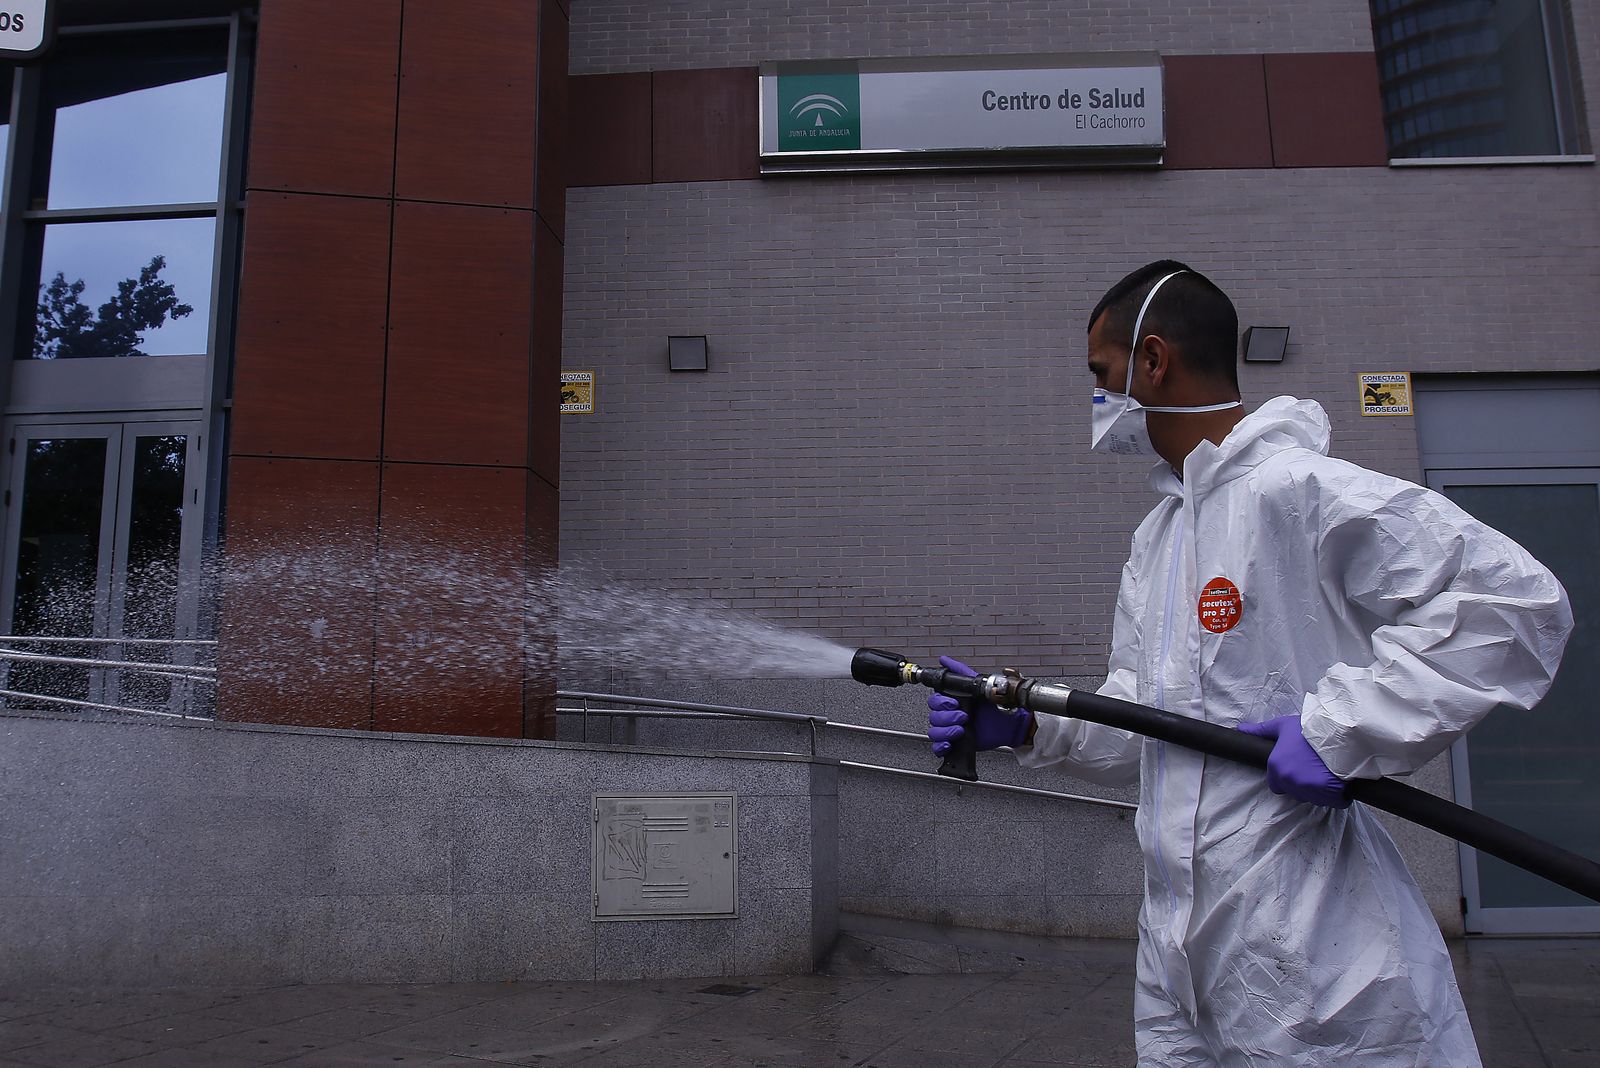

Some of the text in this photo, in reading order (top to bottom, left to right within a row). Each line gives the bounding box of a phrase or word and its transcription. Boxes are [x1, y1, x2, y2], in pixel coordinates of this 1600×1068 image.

[981, 87, 1145, 111] Centro de Salud
[1075, 113, 1146, 129] El Cachorro
[1203, 610, 1217, 618] pro
